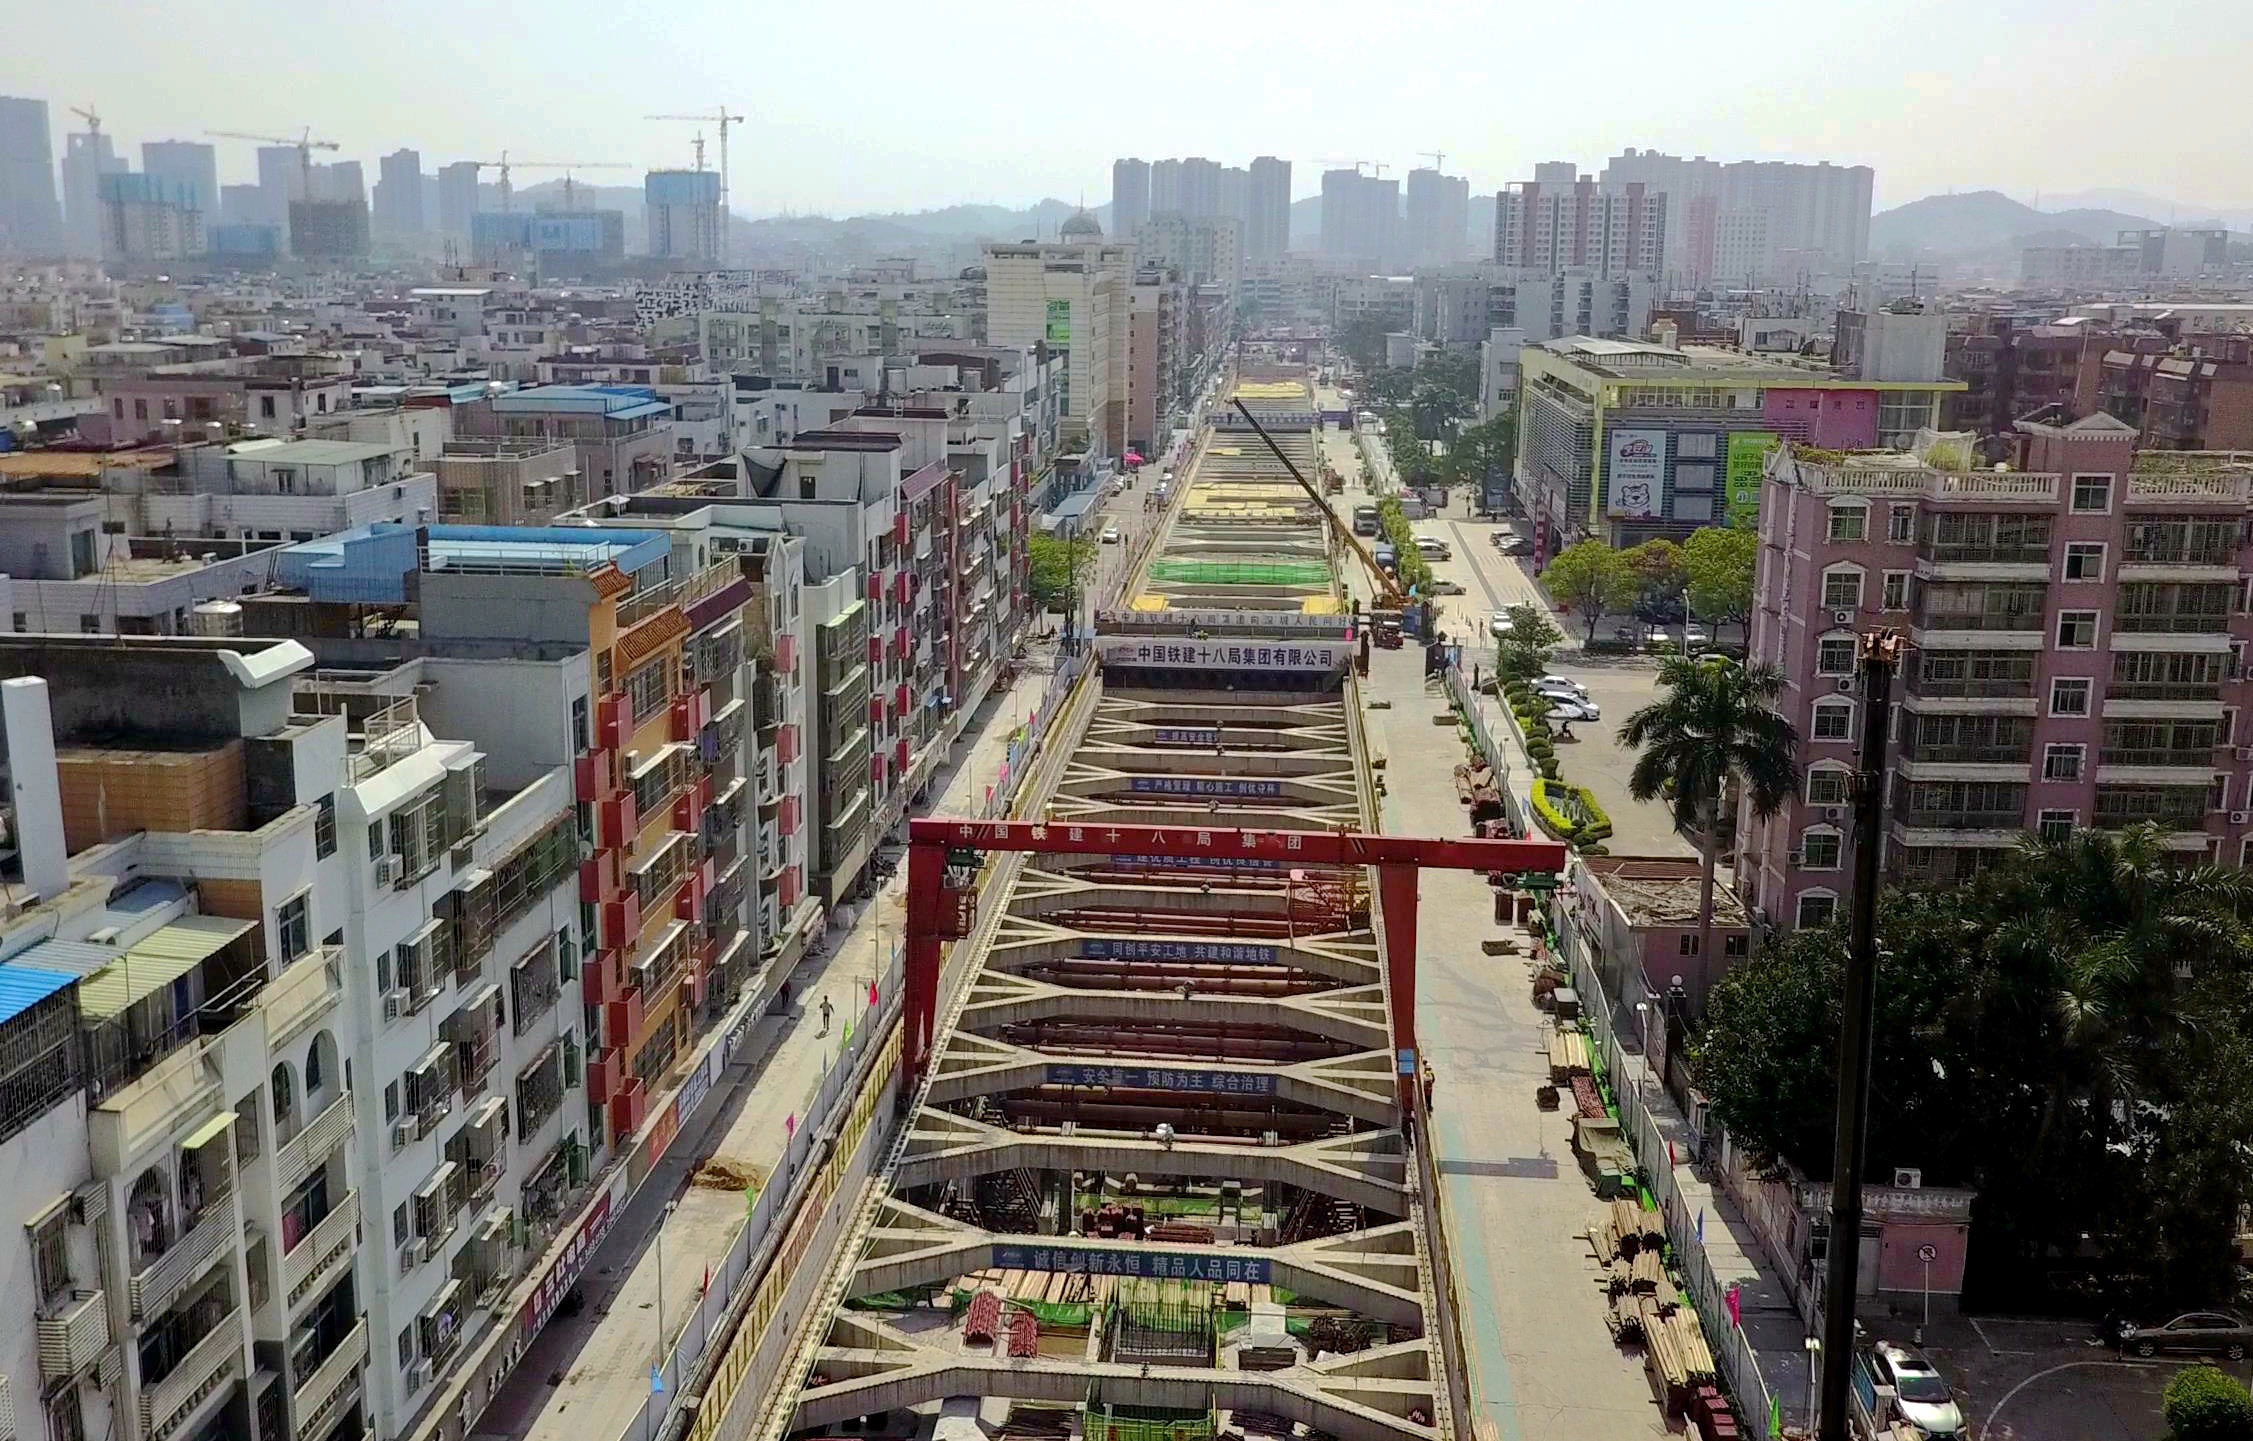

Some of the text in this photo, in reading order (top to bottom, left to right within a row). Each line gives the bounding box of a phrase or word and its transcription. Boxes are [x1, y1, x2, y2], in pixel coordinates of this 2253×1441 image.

[1138, 645, 1332, 667] 中国铁建十八局集团有限公司
[959, 824, 1302, 850] 中国铁建十八局集团
[1112, 942, 1270, 961] 同创平安工地 共建和谐地铁
[1147, 1070, 1204, 1089] 预防为主
[1212, 1074, 1269, 1092] 综合治理
[1152, 1256, 1261, 1281] 精品人品同在
